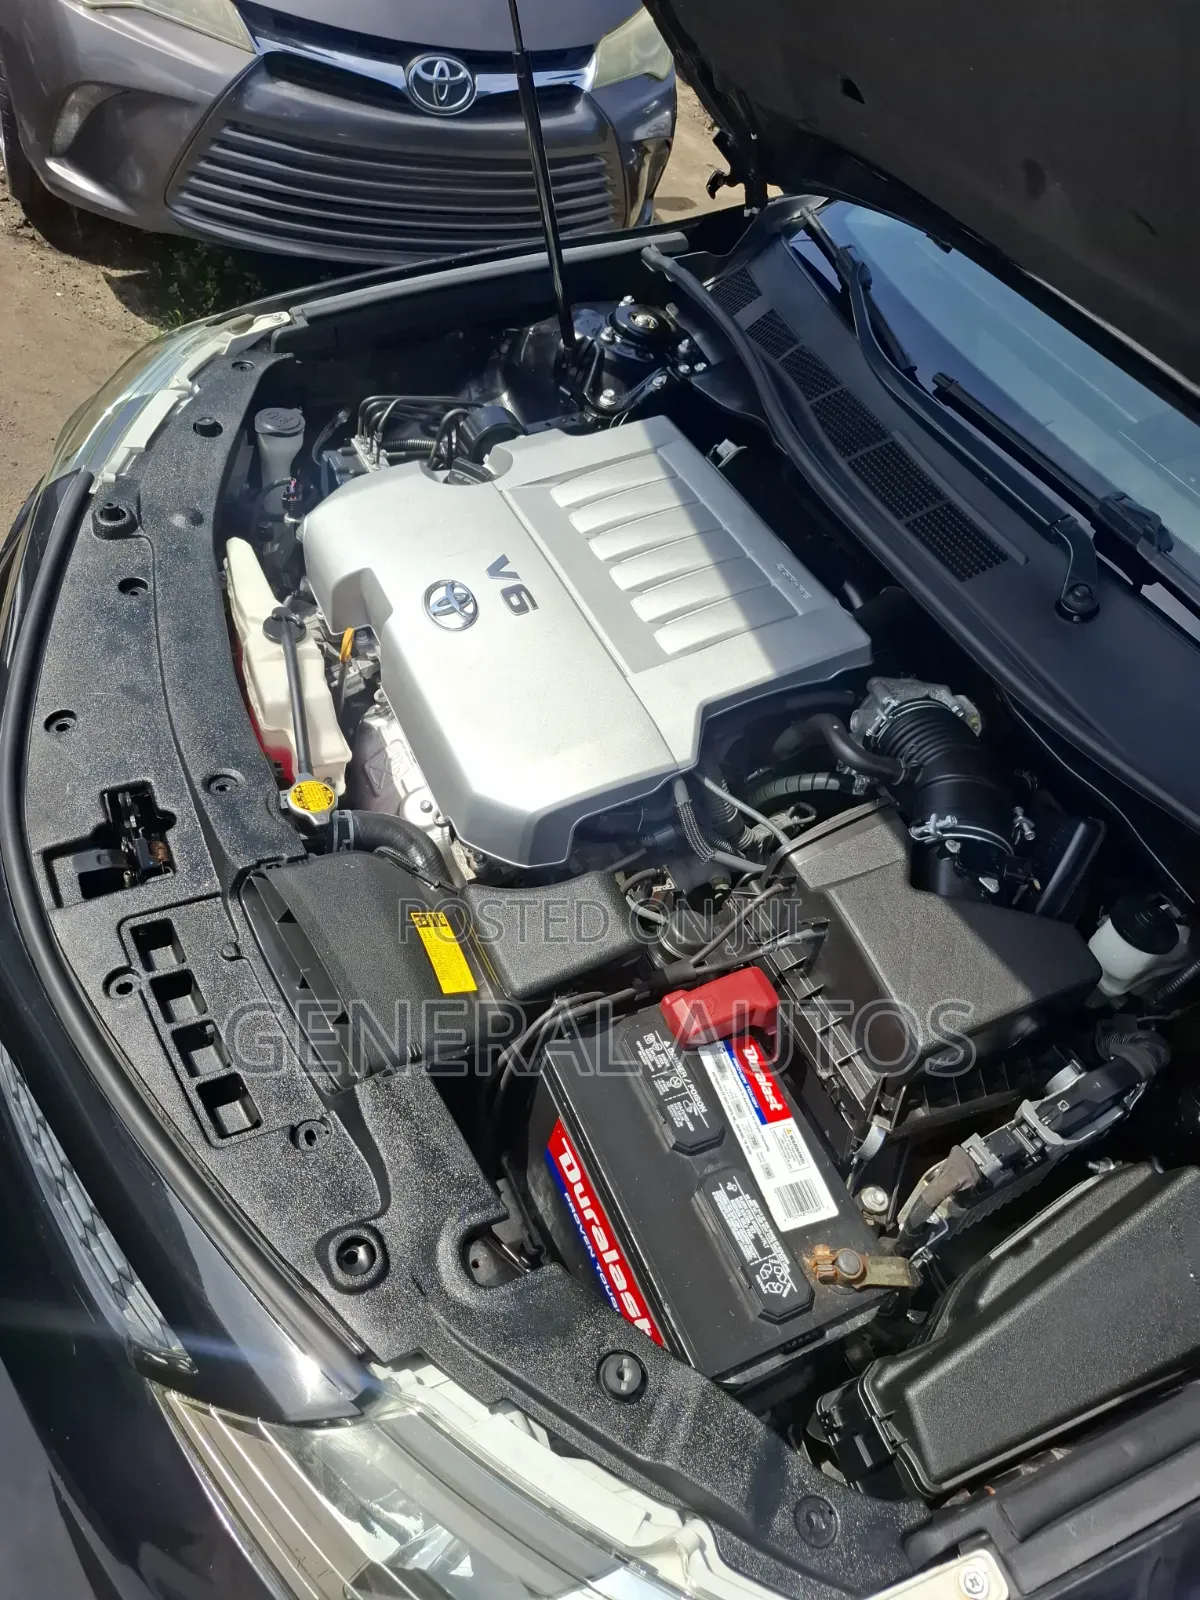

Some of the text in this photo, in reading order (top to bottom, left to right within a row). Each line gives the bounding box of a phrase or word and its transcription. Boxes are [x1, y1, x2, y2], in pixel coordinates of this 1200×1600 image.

[485, 554, 540, 616] V6
[667, 1046, 687, 1077] DANGER
[687, 1083, 707, 1113] POISON
[742, 1044, 783, 1111] Duralast
[556, 1137, 653, 1336] Duralast
[563, 1192, 595, 1258] PROVEN
